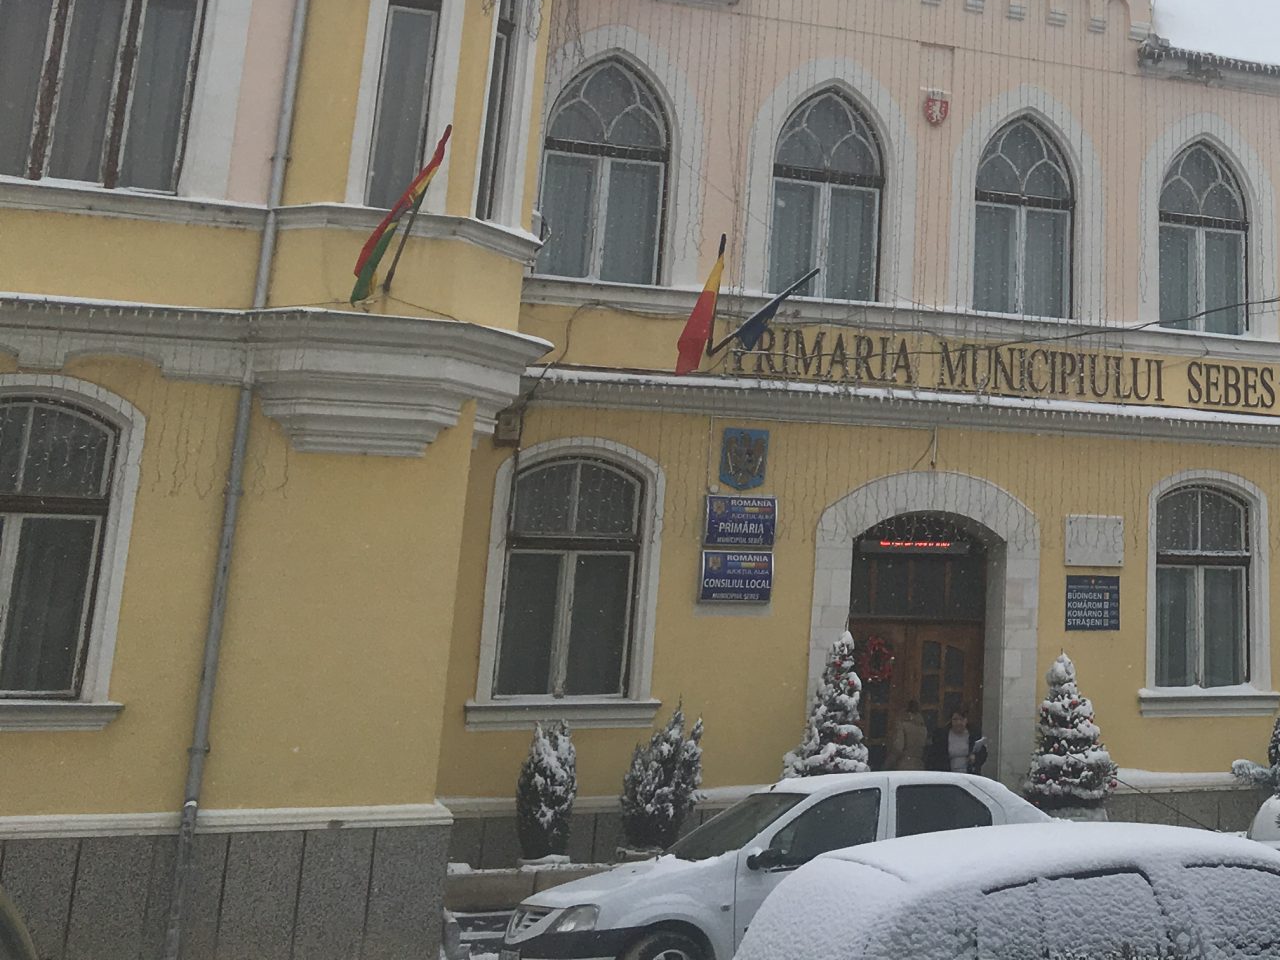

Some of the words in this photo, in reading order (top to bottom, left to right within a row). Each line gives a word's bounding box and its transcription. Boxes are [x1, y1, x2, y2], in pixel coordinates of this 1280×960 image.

[937, 341, 1164, 402] MUNICIPIULUI
[1187, 360, 1276, 409] SEBES
[703, 578, 744, 589] CONSILIUL
[745, 579, 770, 589] LOCAL
